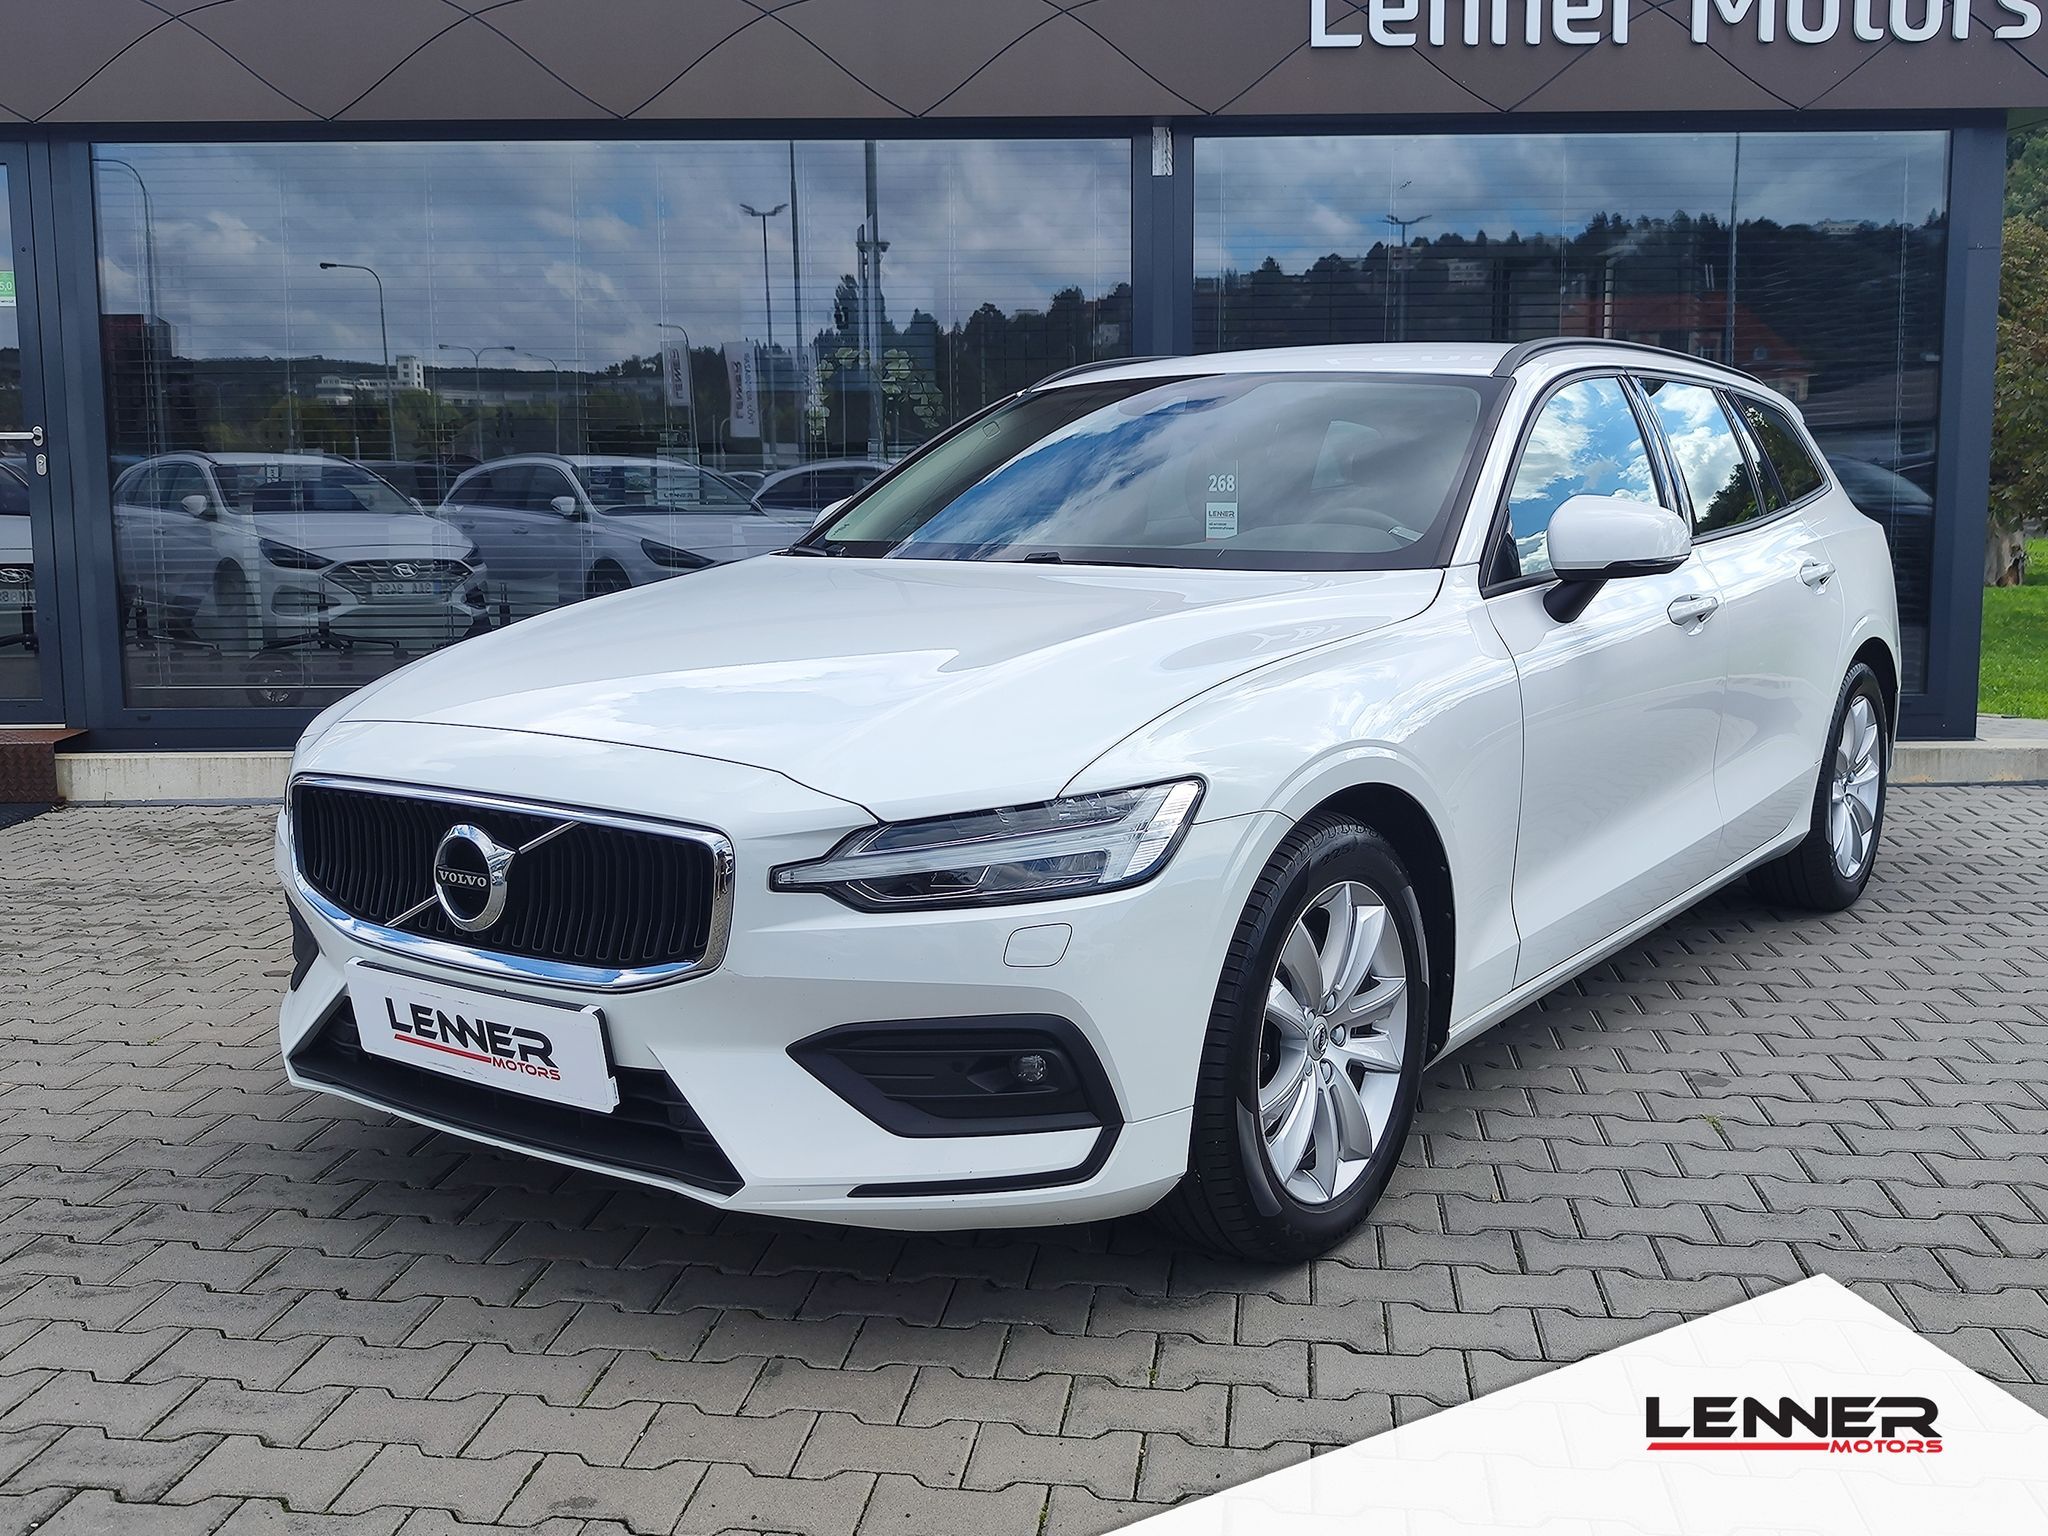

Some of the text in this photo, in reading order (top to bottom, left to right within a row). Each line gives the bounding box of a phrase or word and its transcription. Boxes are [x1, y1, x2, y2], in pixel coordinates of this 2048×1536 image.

[1310, 0, 2043, 48] Lenner Motors
[1208, 474, 1236, 492] 268
[438, 869, 487, 888] VOLVO
[384, 996, 559, 1068] LENNER
[492, 1057, 561, 1081] MOTORS
